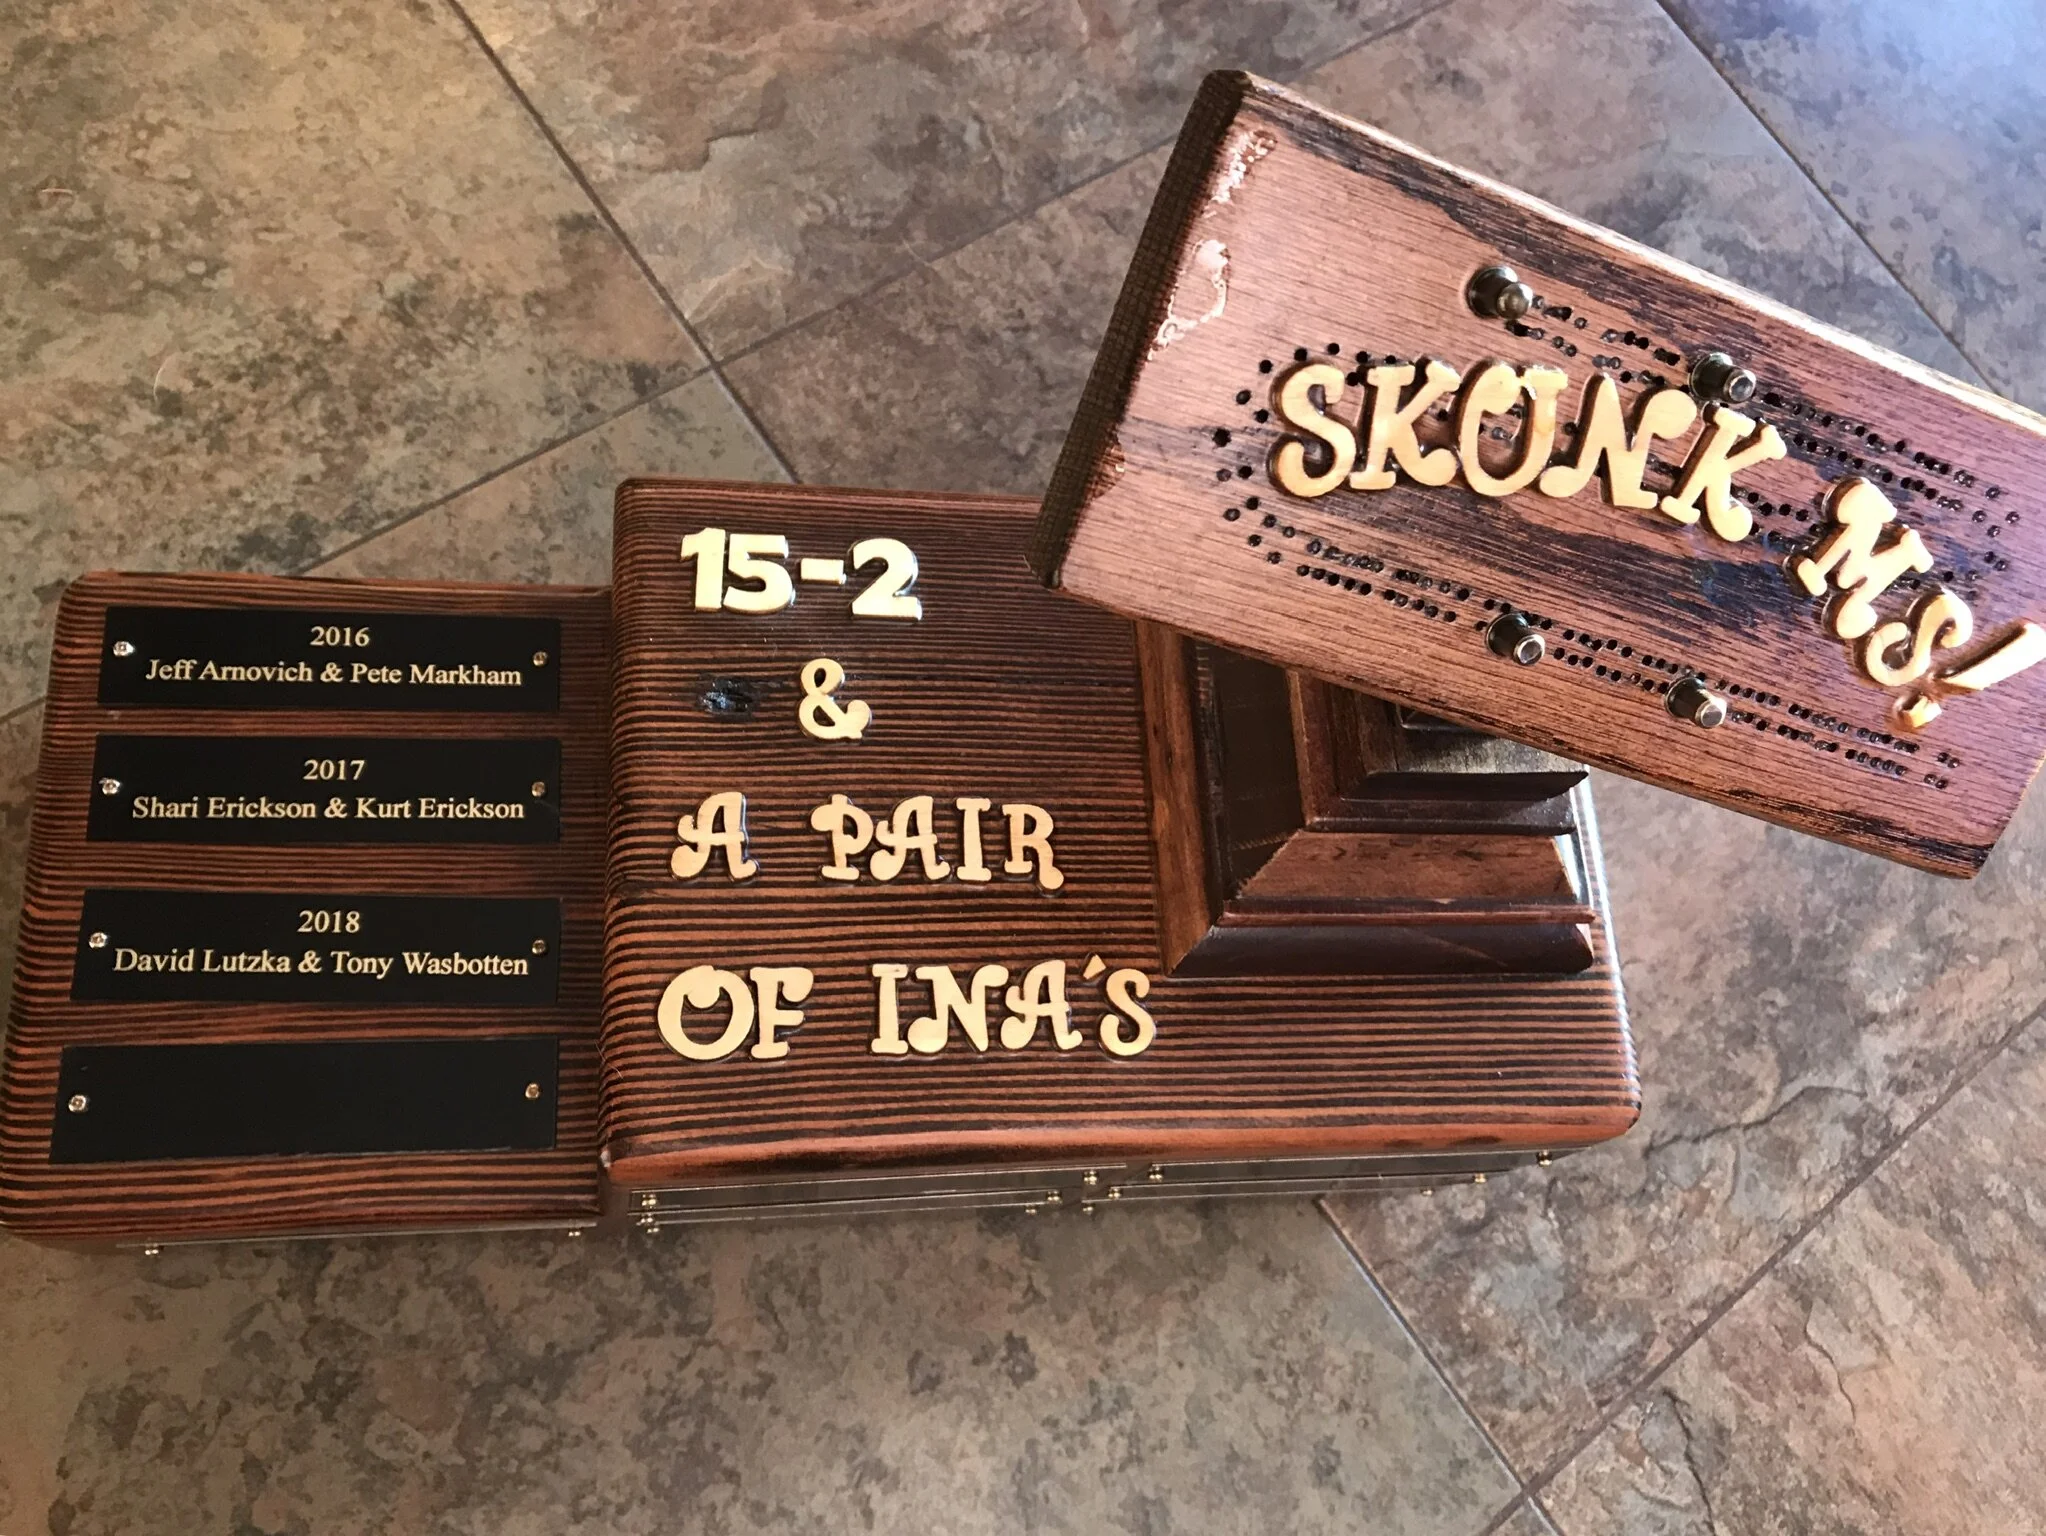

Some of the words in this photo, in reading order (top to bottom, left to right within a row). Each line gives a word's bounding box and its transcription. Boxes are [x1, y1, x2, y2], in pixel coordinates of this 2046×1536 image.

[680, 527, 923, 620] 15-2
[309, 625, 371, 647] 2016
[145, 658, 197, 681] Jeff
[198, 660, 313, 682] Arnovich
[319, 662, 344, 683] &
[349, 662, 403, 684] Pete
[409, 663, 522, 686] Markham
[797, 657, 874, 741] &
[303, 759, 365, 781] 2017
[132, 796, 199, 819] Shari
[207, 796, 317, 819] Erickson
[323, 797, 348, 819] &
[354, 797, 412, 819] Kurt
[417, 797, 525, 819] Erickson
[670, 790, 759, 881] A
[810, 793, 1065, 892] PAIR
[297, 910, 360, 934] 2018
[113, 948, 195, 972] David
[201, 948, 292, 973] Lutzka
[297, 950, 323, 974] &
[330, 950, 394, 980] Tony
[401, 951, 529, 977] Wasbotten
[657, 963, 814, 1062] OF
[870, 952, 1157, 1061] INA'S
